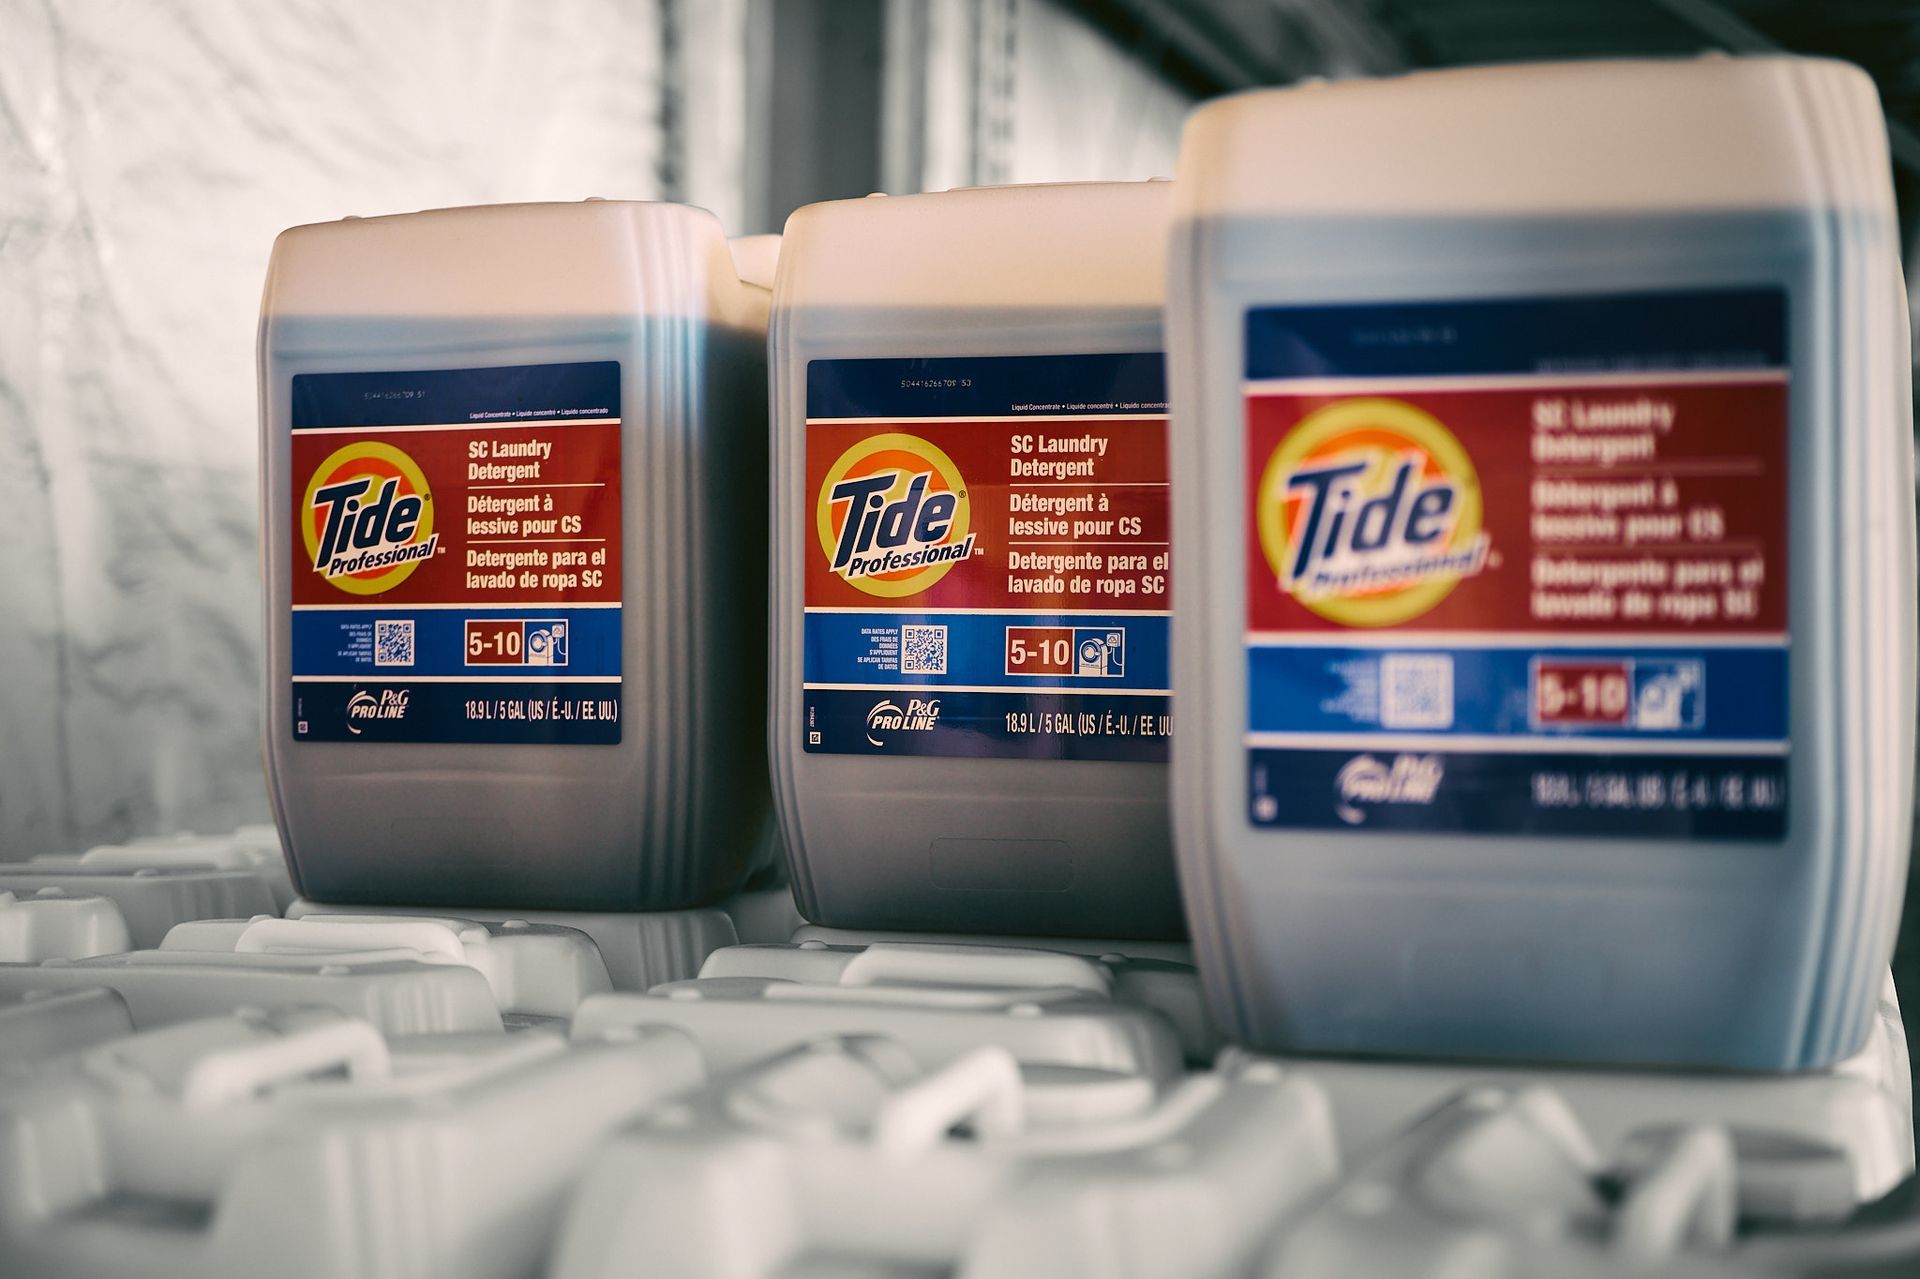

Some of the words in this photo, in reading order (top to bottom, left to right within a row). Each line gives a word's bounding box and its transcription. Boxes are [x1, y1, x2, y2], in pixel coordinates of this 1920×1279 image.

[1028, 403, 1061, 411] Concentrate
[1066, 403, 1086, 411] Liquide
[1087, 402, 1113, 410] concentré
[468, 441, 488, 458] SC
[492, 439, 552, 460] Laundry
[1011, 434, 1033, 453] SC
[1038, 434, 1108, 456] Laundry
[468, 461, 540, 482] Detergent
[1010, 458, 1094, 480] Detergent
[467, 495, 540, 516] Détergent
[543, 493, 553, 511] à
[1010, 493, 1094, 516] Détergent
[1098, 493, 1109, 512] à
[312, 477, 423, 570] Tide
[467, 517, 518, 534] lessive
[522, 519, 558, 537] pour
[561, 515, 582, 533] CS
[830, 472, 957, 571] Tide
[1009, 517, 1069, 535] lessive
[1073, 520, 1114, 539] pour
[1118, 516, 1142, 535] CS
[1286, 457, 1458, 583] Tide
[327, 537, 437, 577] Professional
[466, 549, 548, 570] Detergente
[552, 551, 587, 569] para
[591, 548, 606, 565] el
[847, 536, 973, 577] Professional
[1008, 551, 1103, 573] Detergente
[1107, 554, 1147, 574] para
[1153, 552, 1169, 570] el
[466, 571, 516, 588] lavado
[519, 571, 538, 587] de
[542, 573, 577, 591] ropa
[582, 570, 602, 587] SC
[1008, 575, 1065, 593] lavado
[1070, 575, 1091, 593] de
[1096, 578, 1136, 597] ropa
[1141, 575, 1165, 594] SC
[469, 632, 521, 656] 5-10
[1010, 639, 1070, 666] 5-10
[381, 689, 410, 706] P&G
[906, 699, 941, 717] P&G
[465, 700, 485, 719] 18.9
[486, 701, 492, 719] L
[500, 701, 506, 719] 5
[508, 700, 525, 719] GAL
[528, 699, 544, 722] (US
[1006, 712, 1027, 733] 18.9
[1030, 713, 1036, 733] L
[1045, 713, 1052, 733] 5
[1055, 713, 1075, 733] GAL
[1078, 712, 1095, 736] (US
[1141, 715, 1156, 735] EE.
